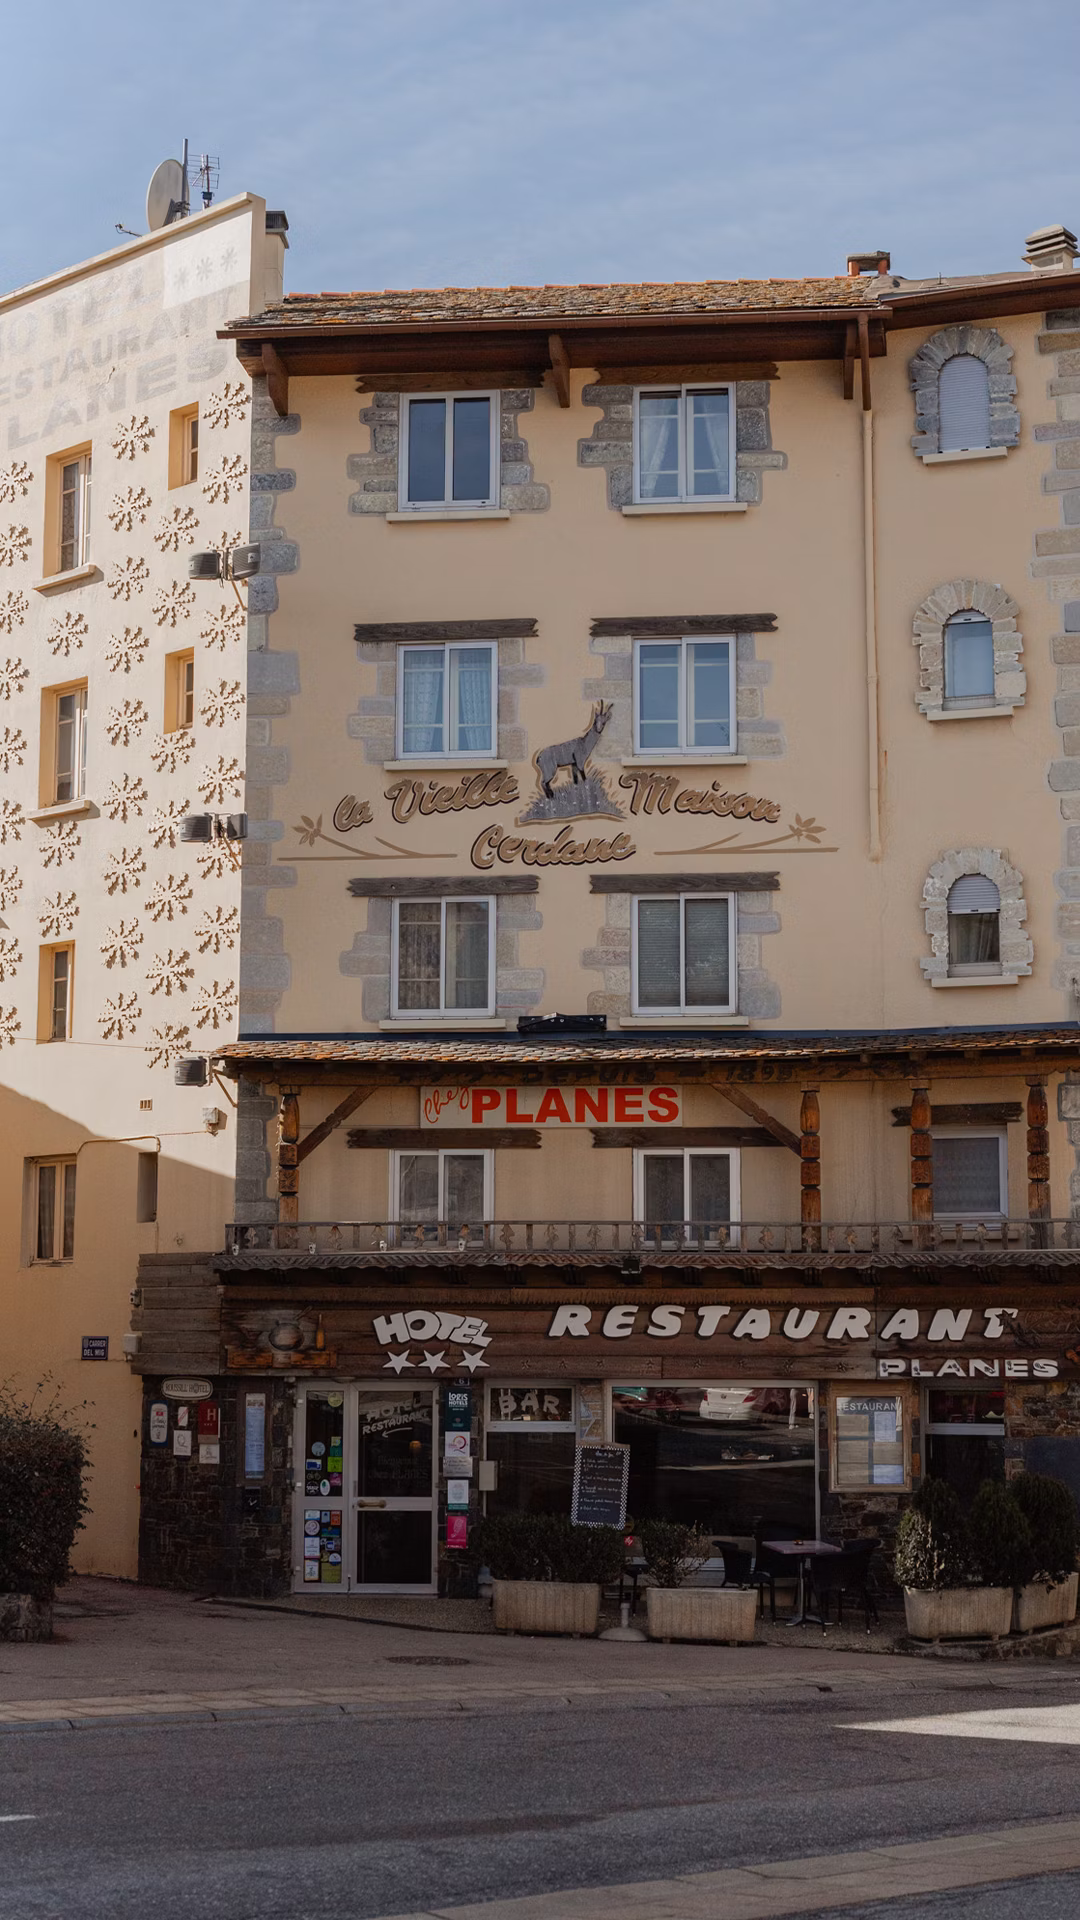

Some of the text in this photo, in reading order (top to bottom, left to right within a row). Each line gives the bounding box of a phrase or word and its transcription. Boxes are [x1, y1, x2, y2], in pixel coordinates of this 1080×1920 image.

[0, 265, 162, 360] OTEL
[384, 771, 520, 824] Vieille
[618, 771, 782, 823] Maison
[470, 824, 636, 870] Cerdane
[471, 1087, 680, 1124] PLANES
[372, 1309, 492, 1347] HOTEL
[548, 1304, 1019, 1341] RESTAURANT
[879, 1358, 1060, 1379] PLANES
[207, 1408, 217, 1421] H
[366, 1397, 423, 1421] HOTEL
[498, 1391, 560, 1416] BAR
[839, 1402, 898, 1411] ESTAURAN
